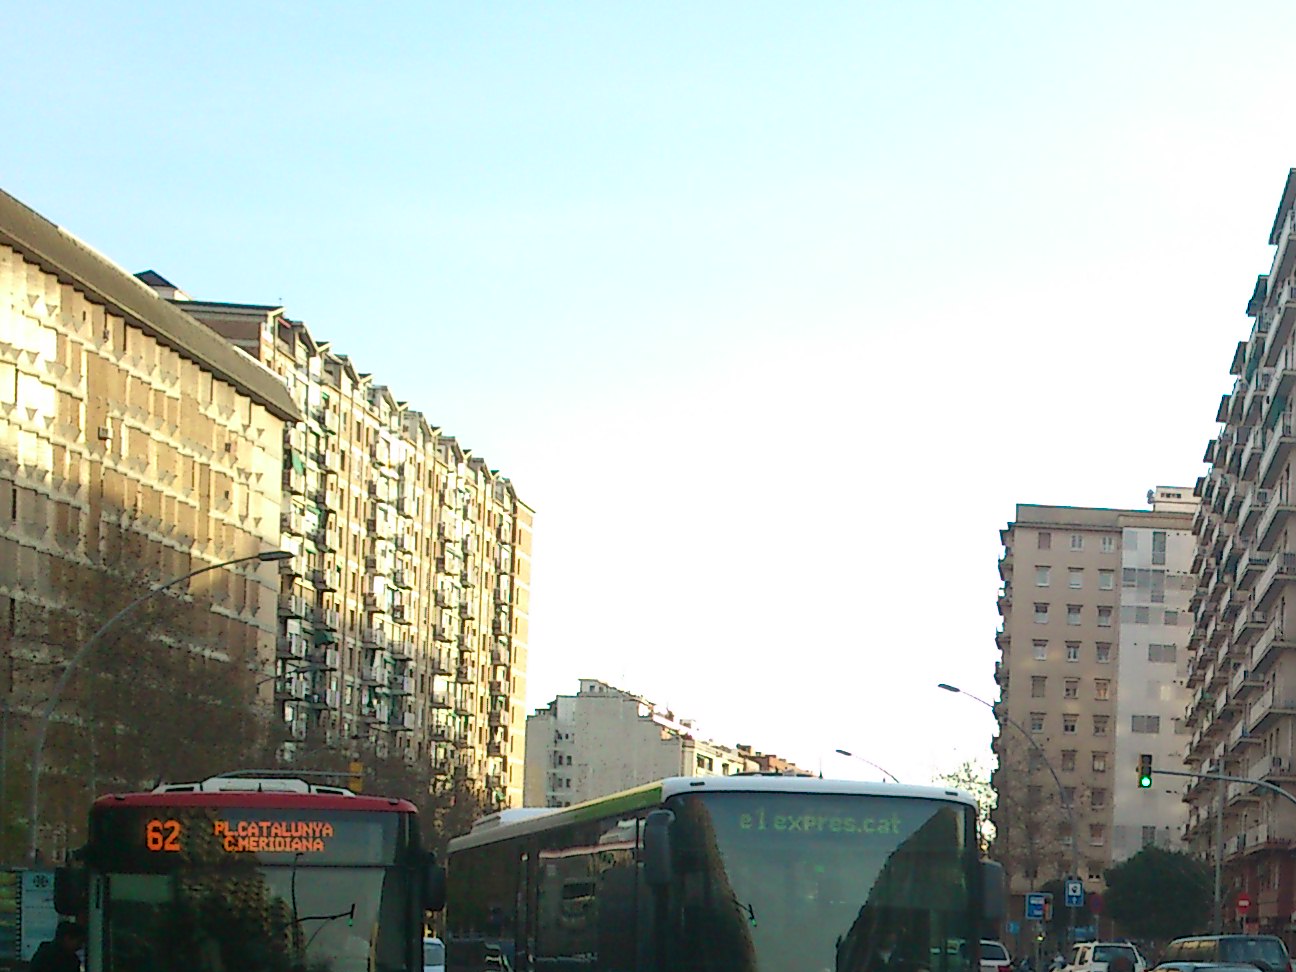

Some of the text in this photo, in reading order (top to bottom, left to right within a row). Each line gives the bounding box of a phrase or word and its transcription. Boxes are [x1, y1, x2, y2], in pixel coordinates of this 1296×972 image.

[147, 820, 181, 850] 62
[213, 821, 334, 836] PL.CATALUNYA
[223, 837, 325, 851] C.MERIDIANA
